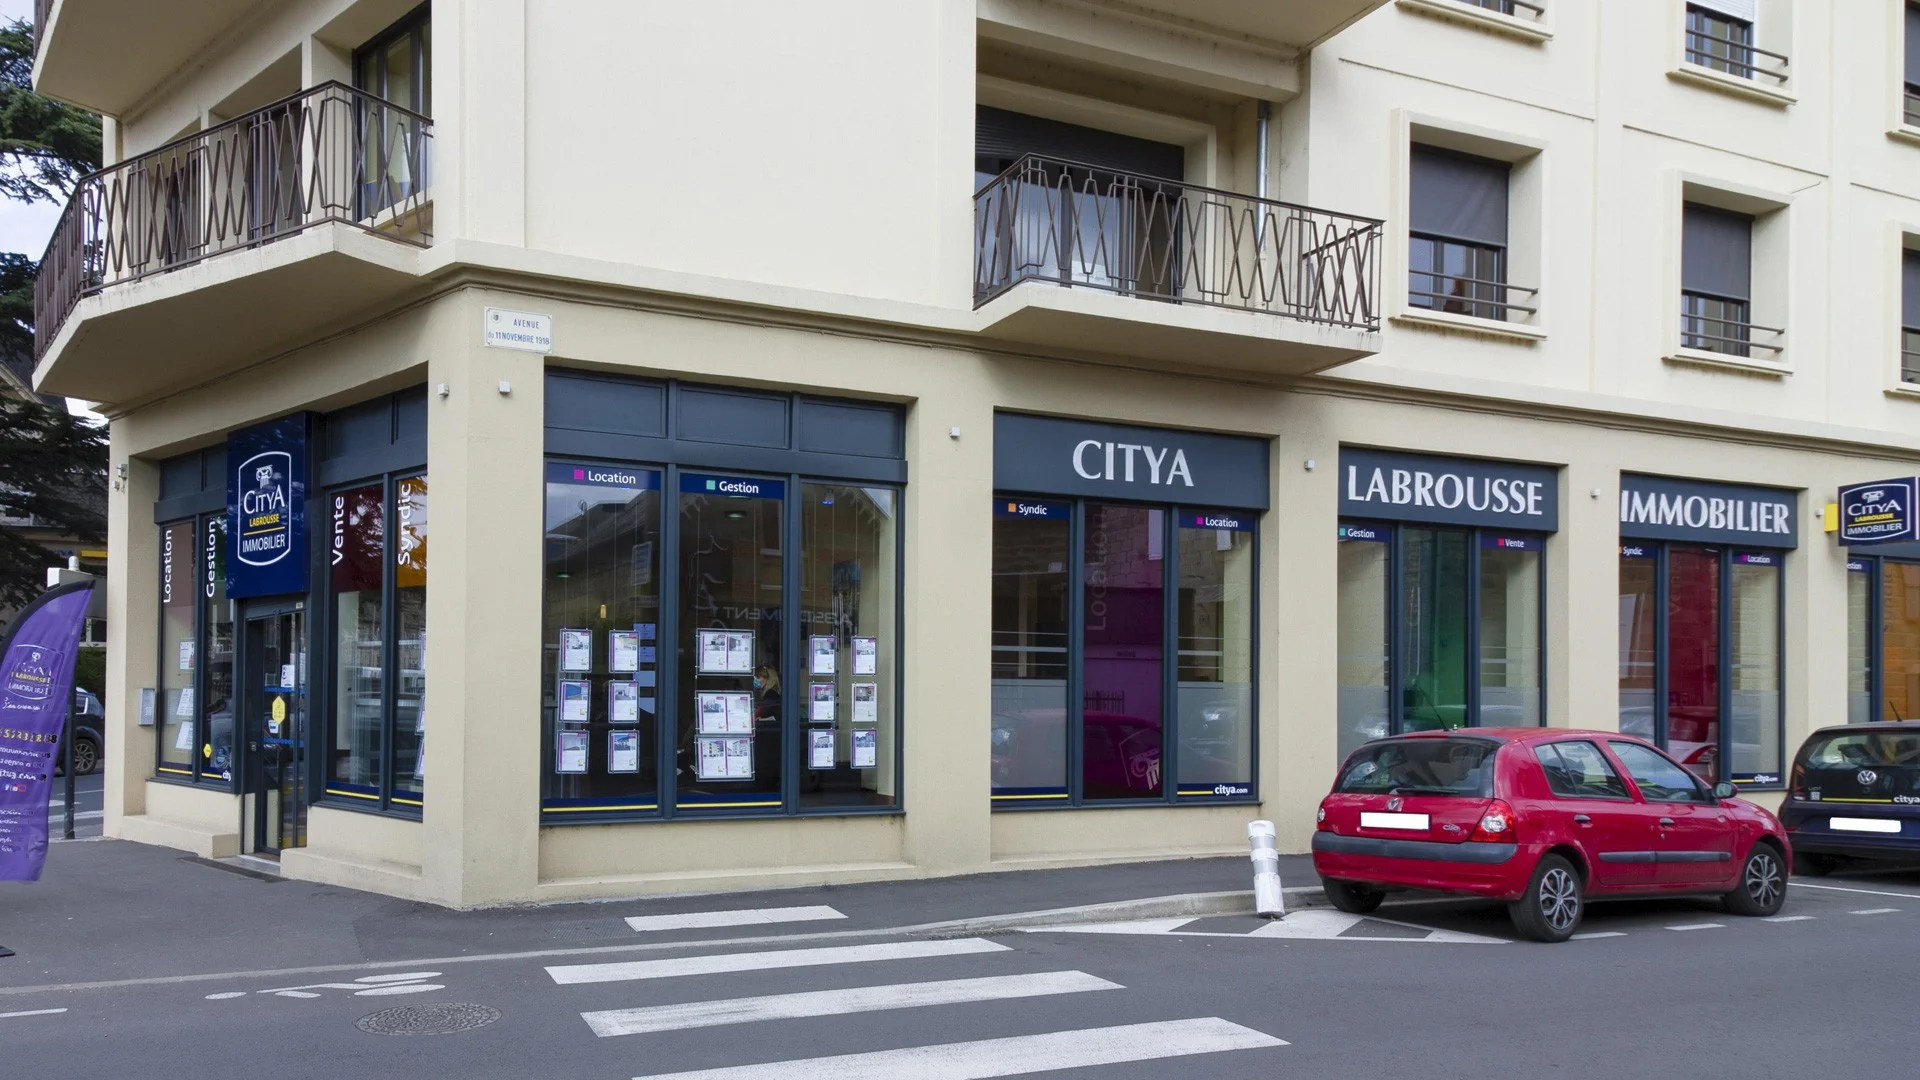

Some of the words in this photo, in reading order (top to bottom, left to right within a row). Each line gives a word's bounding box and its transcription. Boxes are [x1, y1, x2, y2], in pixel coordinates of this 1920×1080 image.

[513, 318, 540, 330] AVENUE
[487, 331, 495, 339] du
[495, 331, 501, 340] 11
[502, 332, 534, 344] NOVEMBRE
[535, 336, 550, 345] 1918
[1072, 439, 1194, 487] CITYA
[588, 470, 636, 484] Location
[719, 481, 759, 494] Gestion
[1347, 465, 1543, 515] LABROUSSE
[243, 484, 286, 515] CITYA
[1018, 503, 1048, 516] Syndic
[1620, 489, 1791, 534] IMMOBILIER
[1847, 499, 1903, 516] CITYA
[249, 513, 280, 528] LABROUSSE
[398, 483, 414, 565] Syndic
[1205, 516, 1238, 528] Location
[1854, 512, 1894, 523] LABROUSSE
[332, 496, 345, 566] Vente
[1347, 528, 1375, 539] Gestion
[1847, 522, 1903, 535] IMMOBILIER
[242, 533, 286, 553] IMMOBILIER
[1505, 539, 1525, 548] Vente
[1623, 546, 1643, 556] Syndic
[163, 529, 173, 604] Location
[206, 521, 216, 598] Gestion
[1747, 555, 1771, 564] Location
[1847, 562, 1862, 570] estion
[1214, 784, 1248, 796] citya.com
